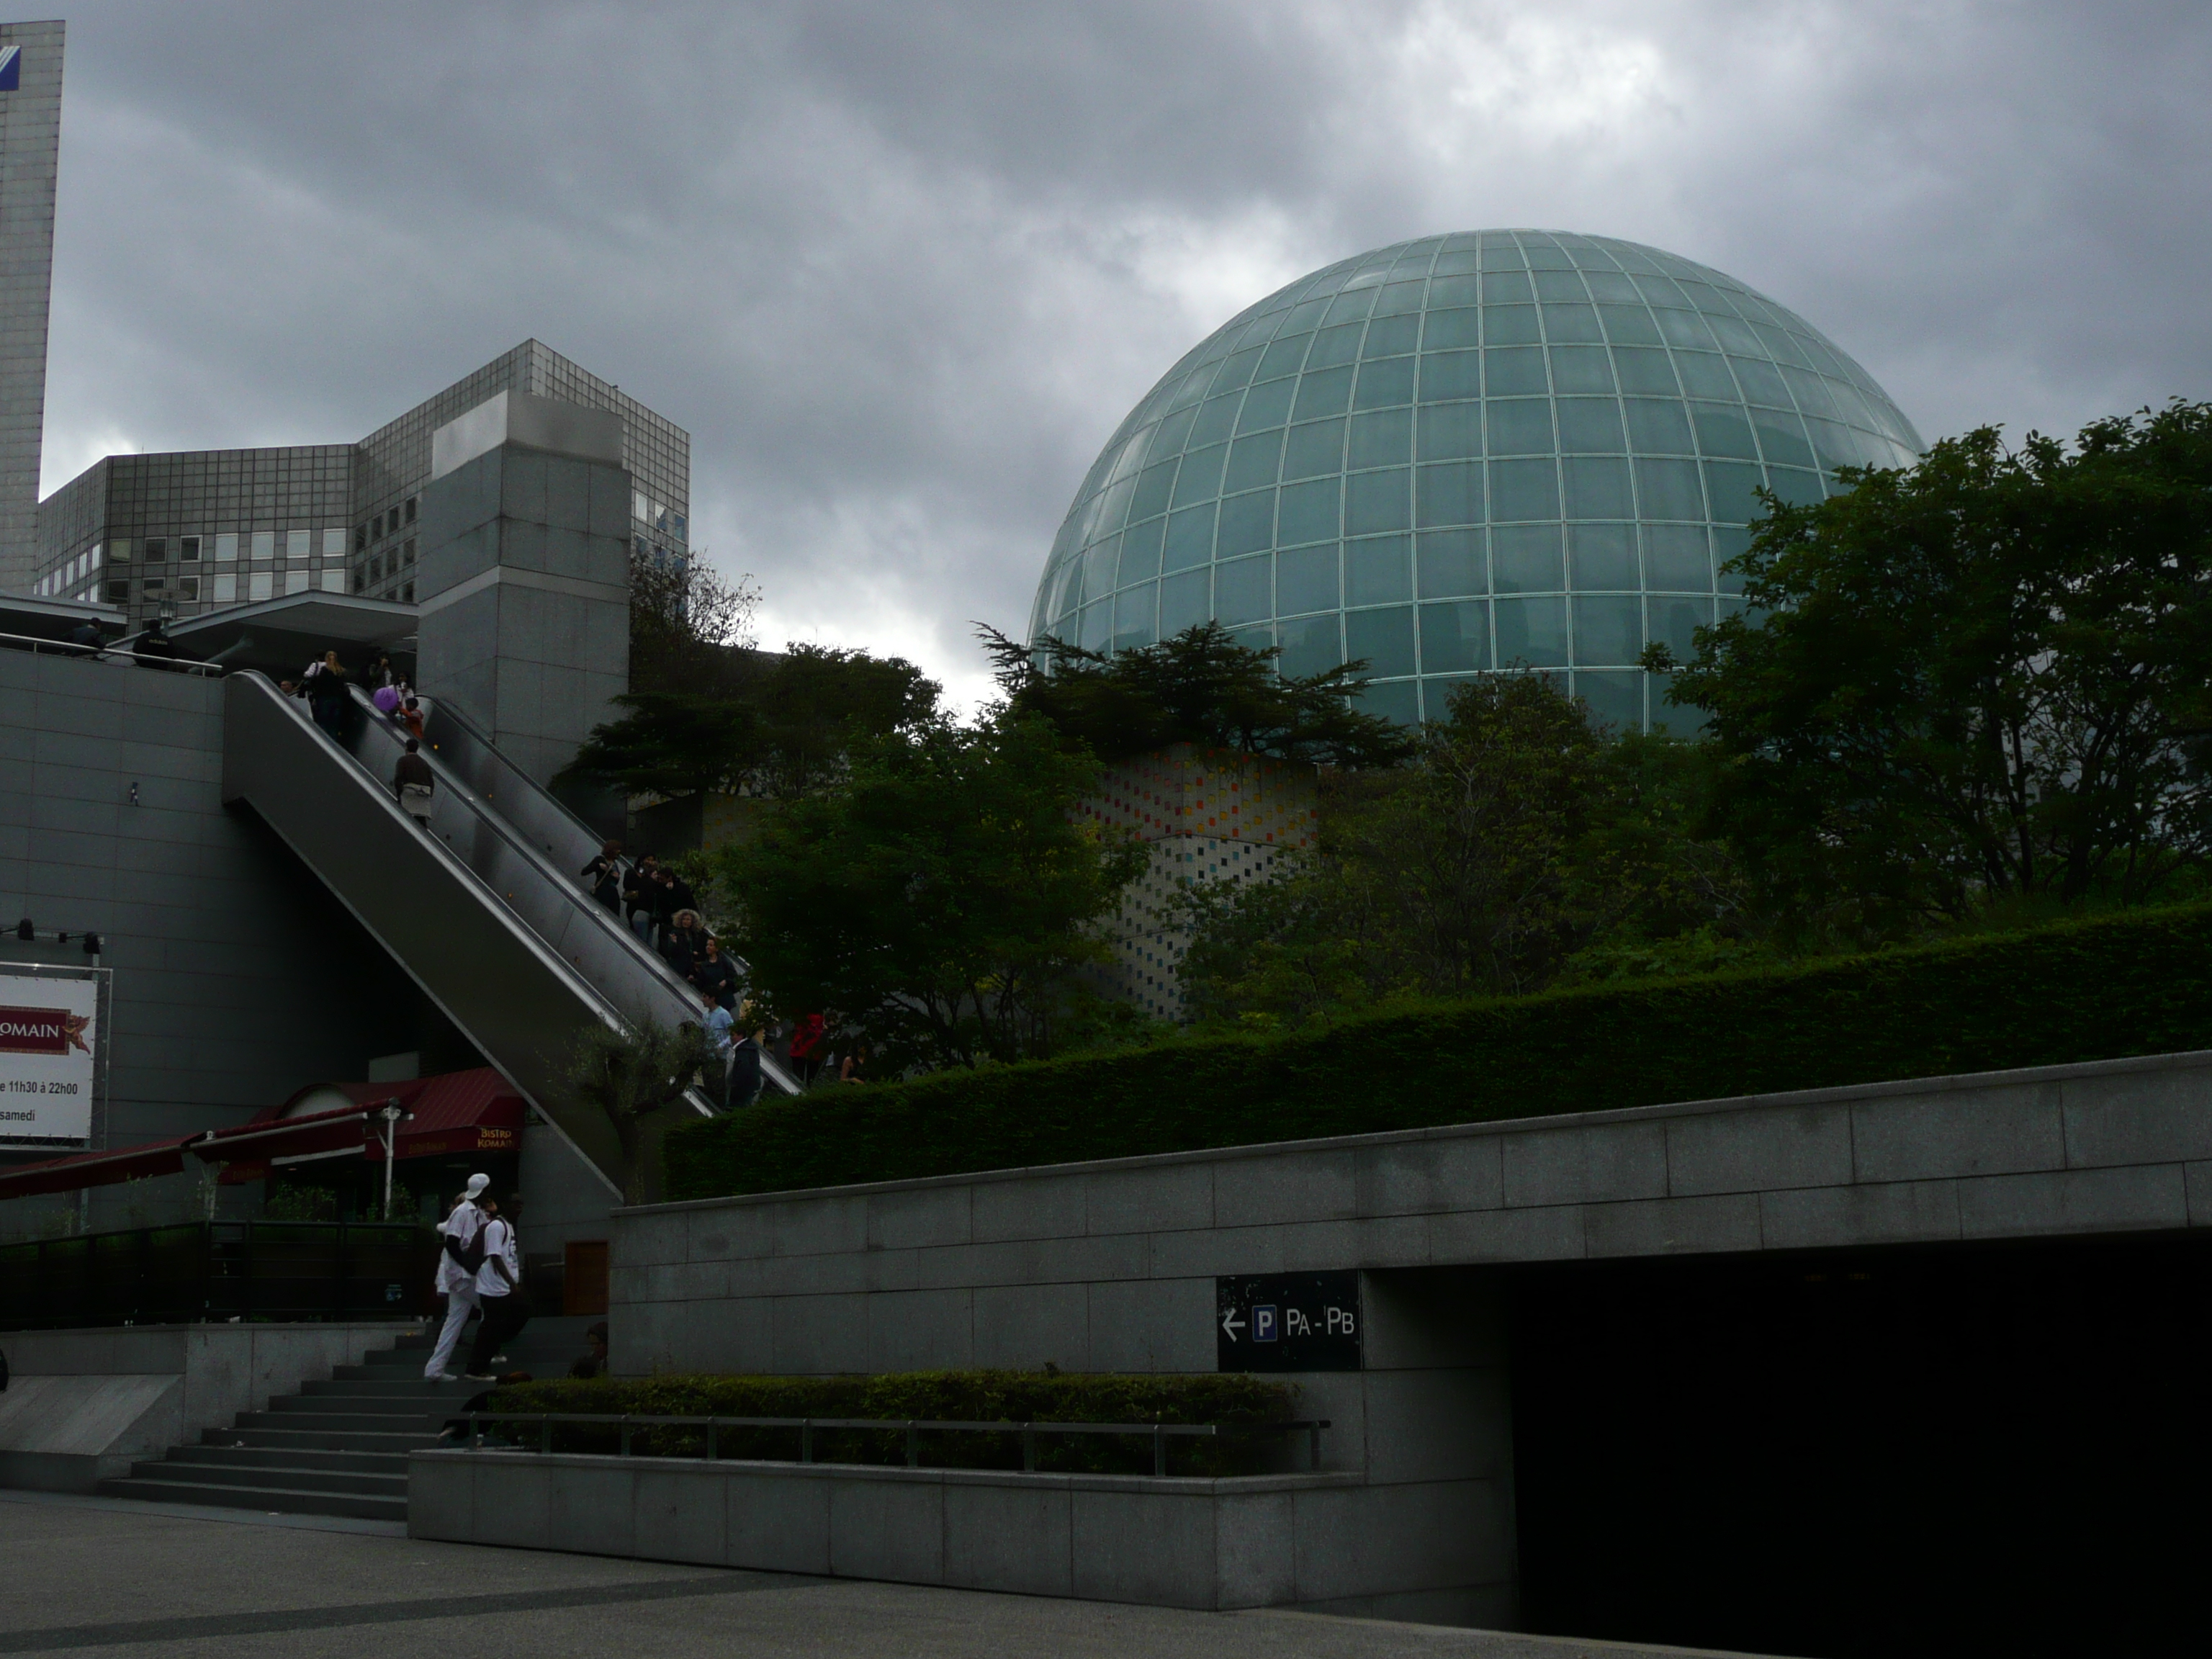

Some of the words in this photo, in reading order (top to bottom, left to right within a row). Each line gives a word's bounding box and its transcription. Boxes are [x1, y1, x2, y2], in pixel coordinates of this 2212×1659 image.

[0, 1022, 60, 1038] OMAIN
[0, 1083, 6, 1092] e
[9, 1080, 37, 1094] 11h30
[40, 1081, 46, 1094] à
[49, 1082, 78, 1094] 22h00
[0, 1110, 35, 1121] samedi
[480, 1128, 512, 1139] BISTRO
[1258, 1310, 1273, 1337] P
